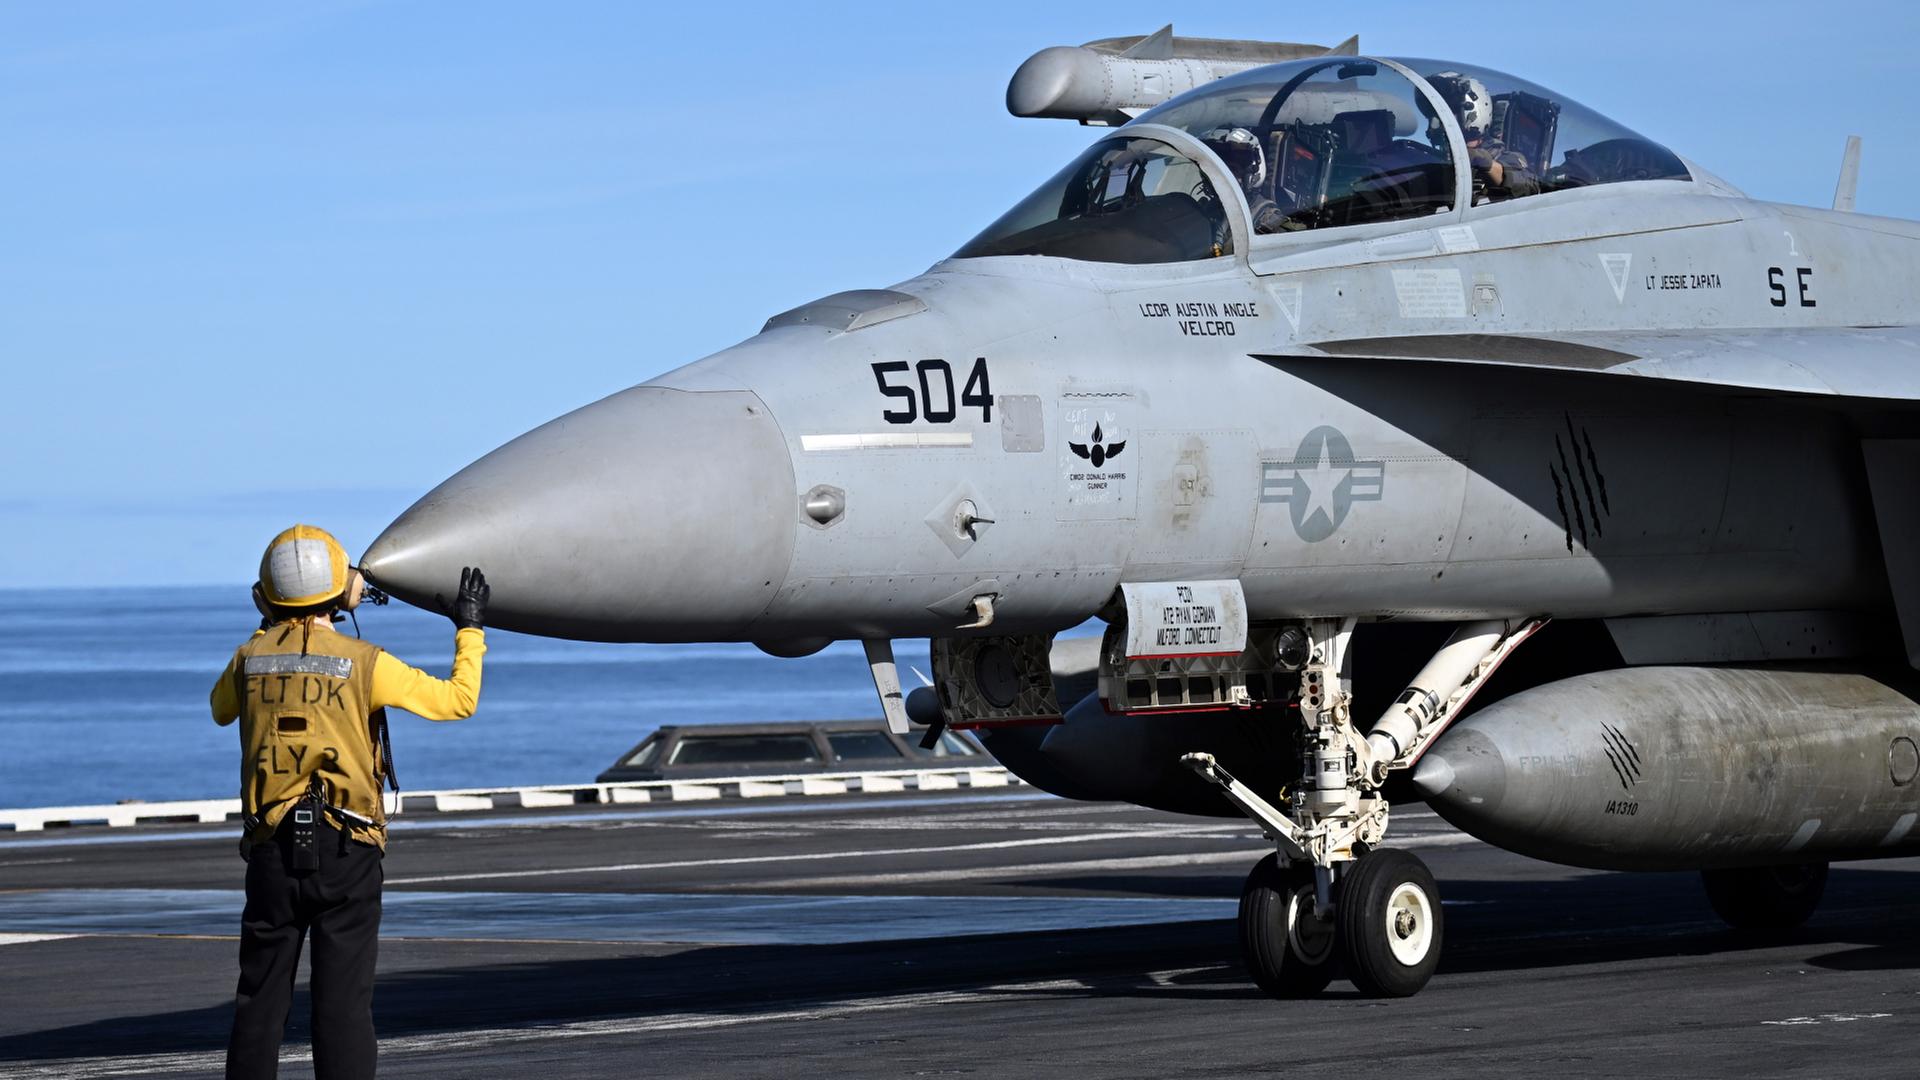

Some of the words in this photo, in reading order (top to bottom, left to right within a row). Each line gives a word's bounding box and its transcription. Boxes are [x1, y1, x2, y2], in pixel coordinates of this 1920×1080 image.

[1646, 275, 1656, 290] LT
[1661, 275, 1688, 290] JESSIE
[1691, 274, 1721, 289] ZAPATA
[1139, 303, 1171, 317] LCDR
[1176, 303, 1218, 317] AUSTIN
[1223, 302, 1259, 317] ANGLE
[1179, 321, 1236, 336] VELCRO
[870, 357, 994, 424] 504
[1107, 472, 1127, 480] HARRIS
[1087, 482, 1108, 490] GUNNER
[1175, 606, 1191, 624] RYAN
[1192, 605, 1217, 623] GORMAN
[1184, 626, 1221, 645] CONNECTICUT
[246, 676, 292, 704] FLT
[302, 677, 345, 711] DK
[256, 745, 307, 775] FLY
[1605, 800, 1639, 816] IA1310
